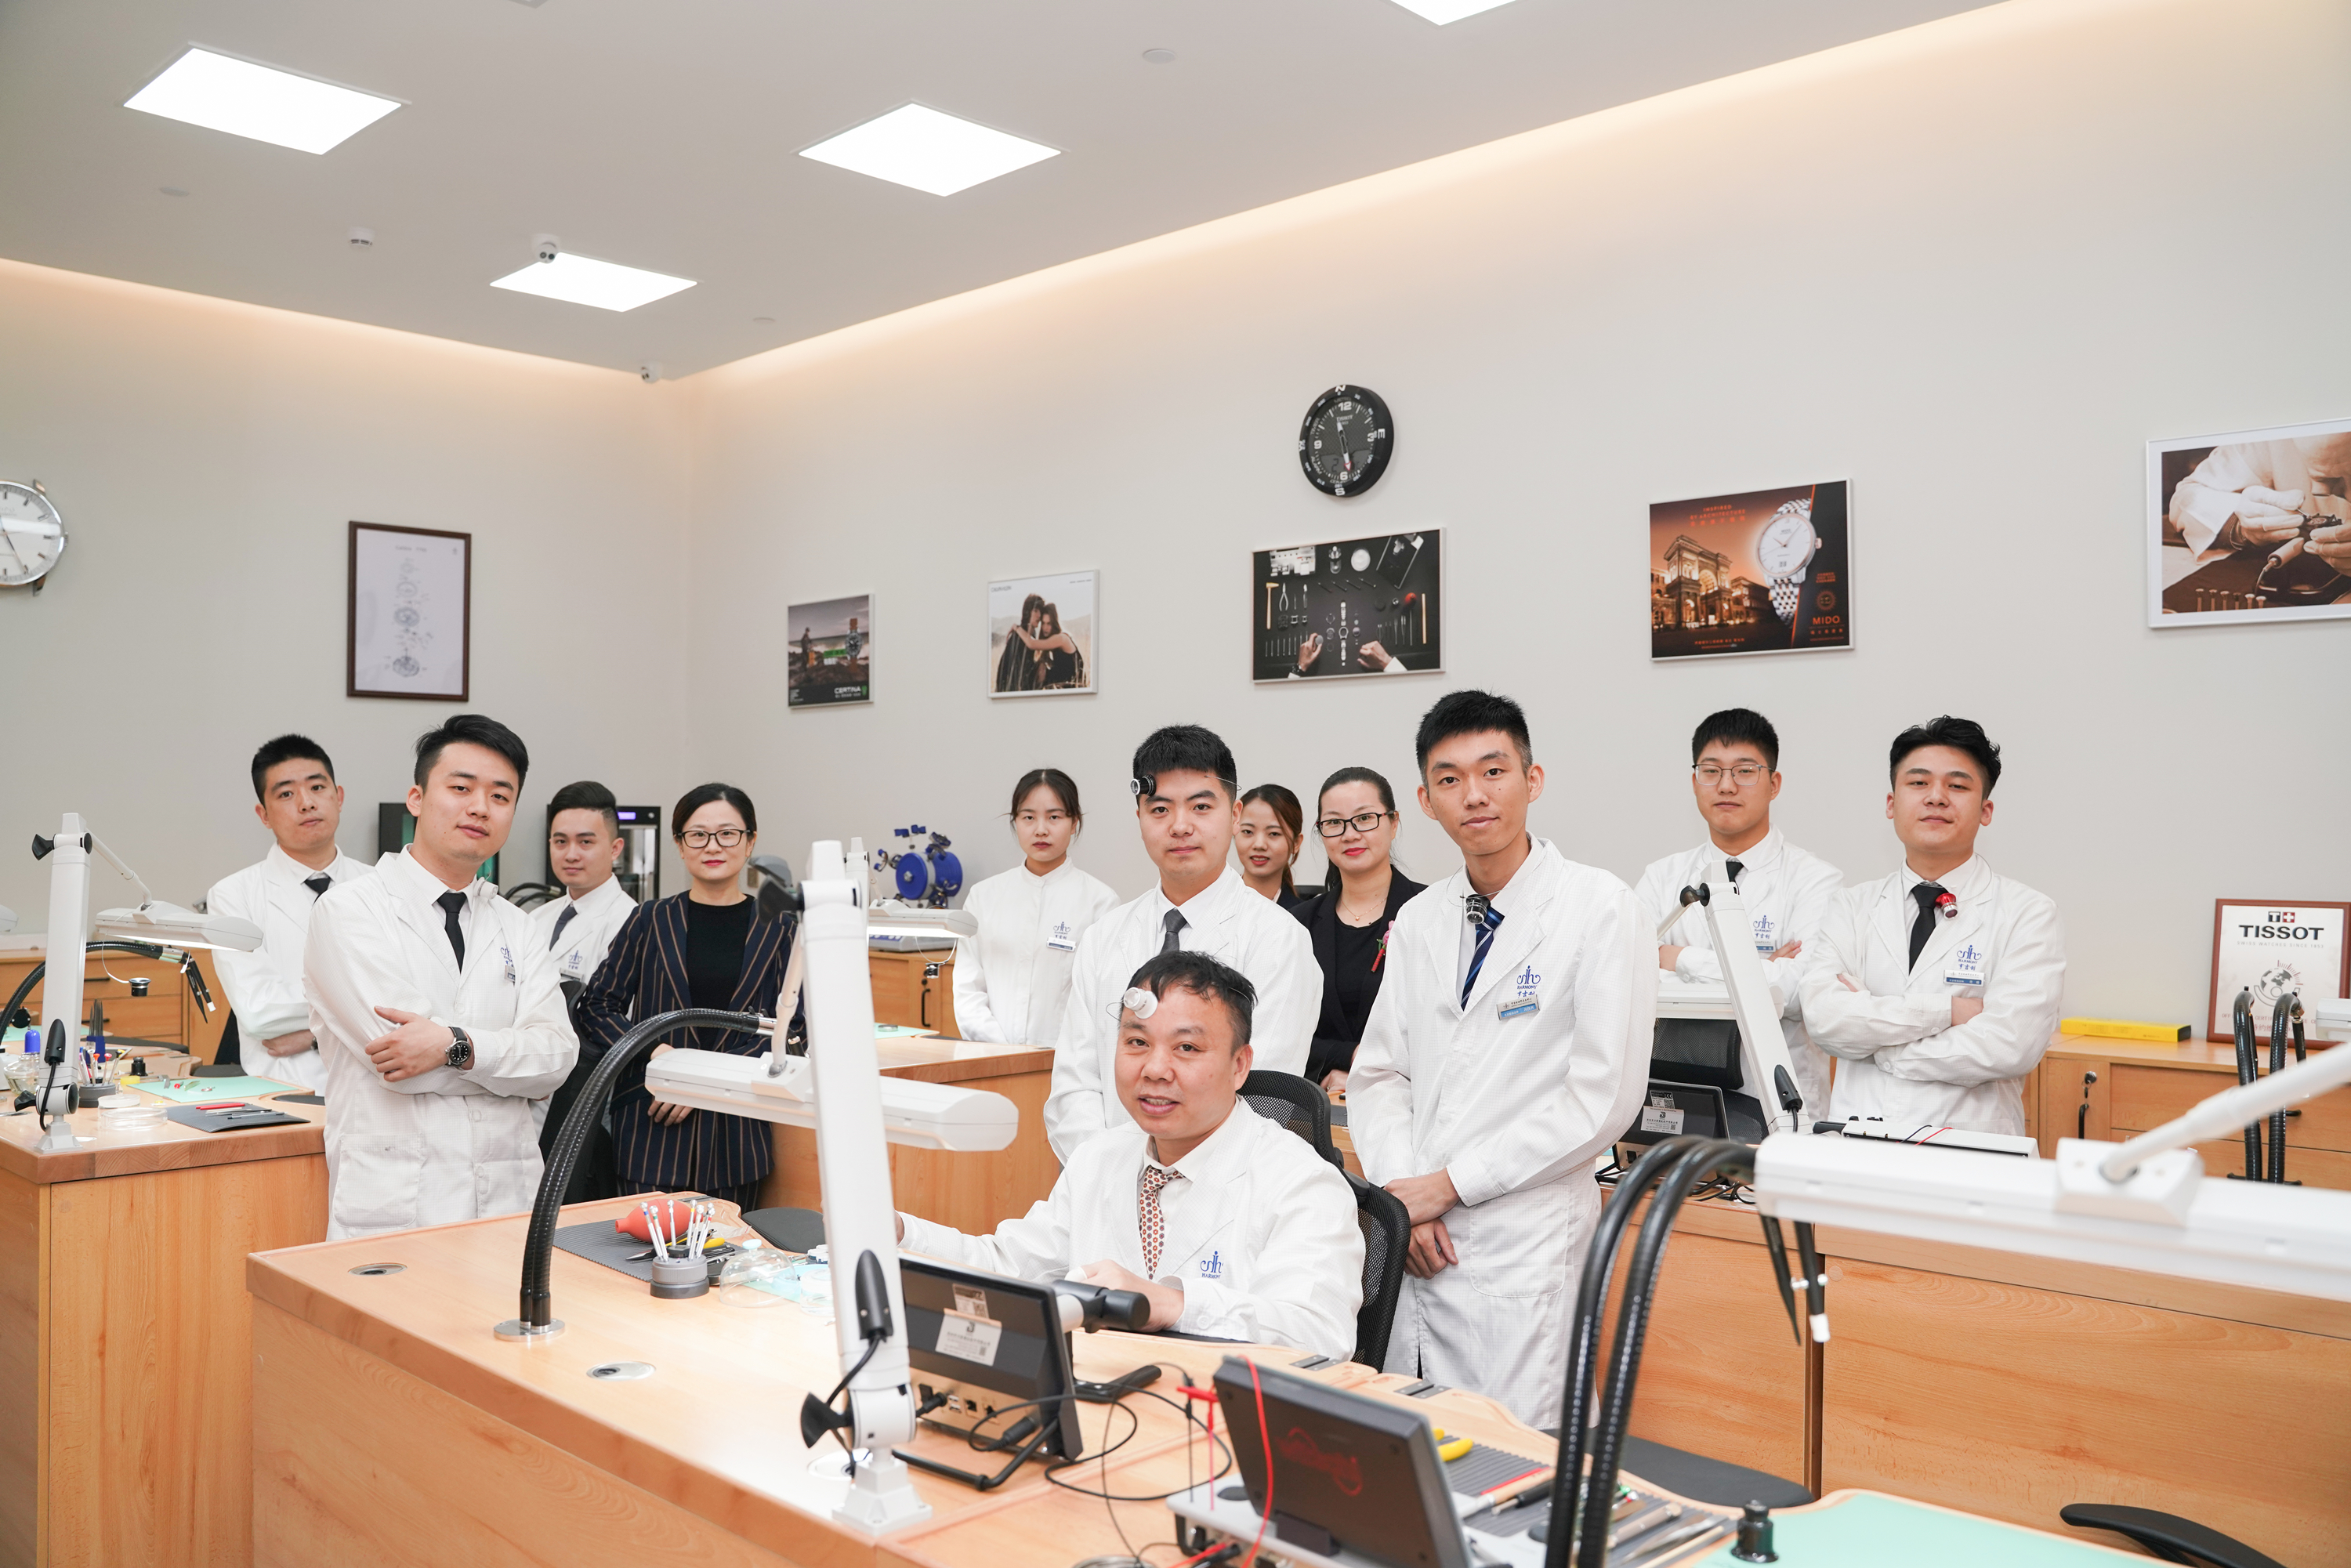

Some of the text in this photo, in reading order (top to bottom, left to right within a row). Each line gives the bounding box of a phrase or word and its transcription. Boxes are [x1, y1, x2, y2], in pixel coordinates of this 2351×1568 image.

[1338, 401, 1352, 411] 12
[1367, 432, 1375, 442] 3
[1378, 428, 1386, 439] E
[1314, 440, 1323, 449] 9
[1340, 471, 1348, 480] 6
[1335, 487, 1346, 496] S
[1812, 615, 1840, 625] MIDO
[2238, 925, 2324, 940] TISSOT
